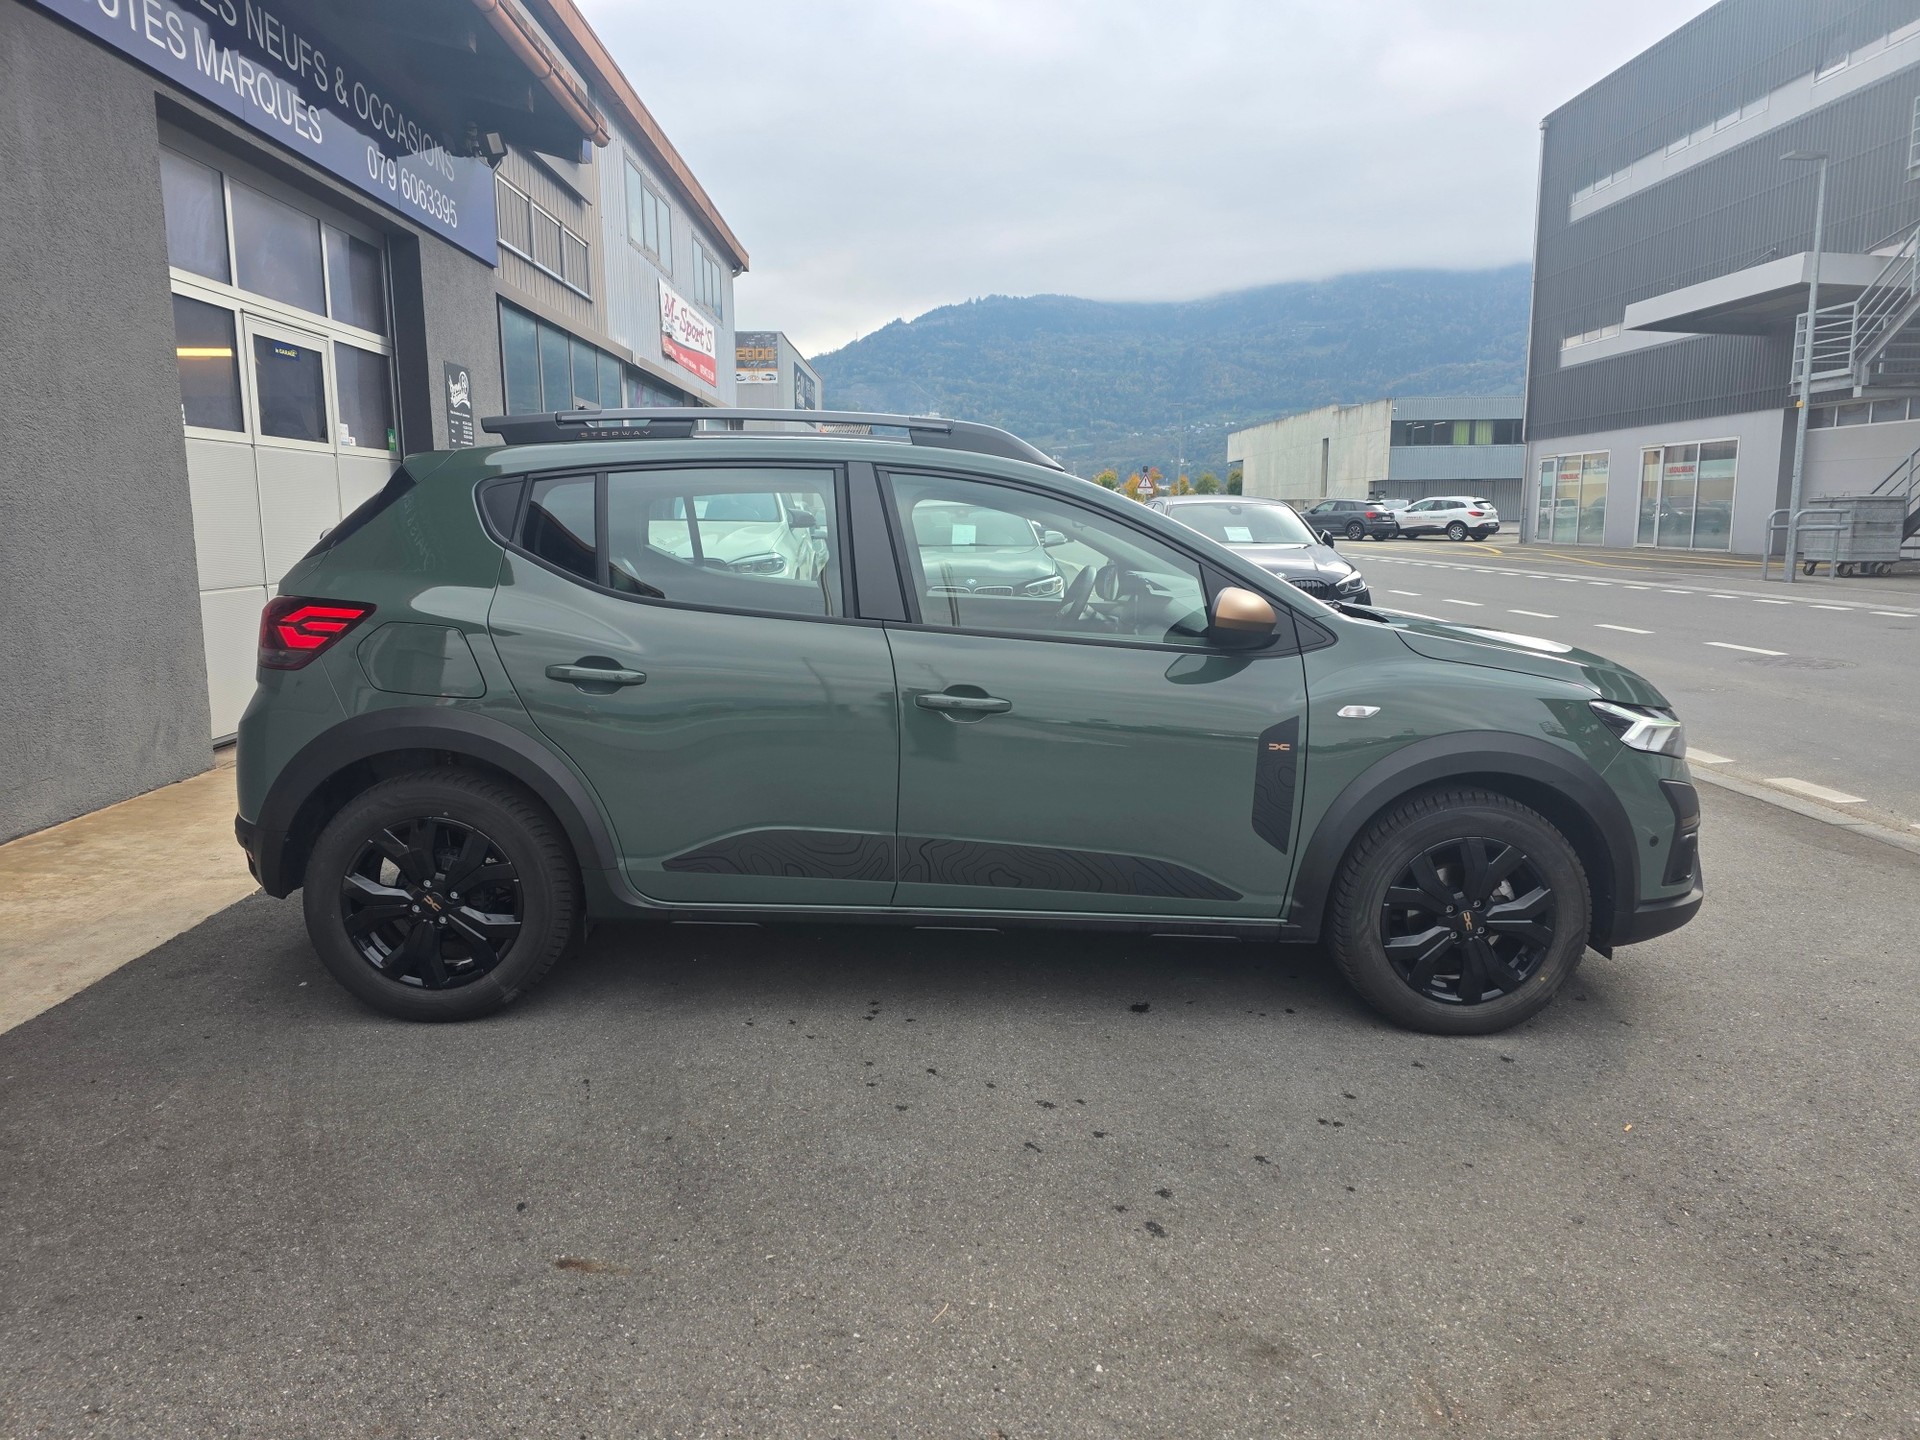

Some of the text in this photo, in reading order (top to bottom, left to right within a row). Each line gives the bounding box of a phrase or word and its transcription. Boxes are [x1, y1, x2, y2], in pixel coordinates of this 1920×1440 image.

[193, 27, 323, 144] MARQUES
[245, 0, 455, 182] NEUFS & OCCASIONS
[366, 146, 458, 228] 079 6063395
[581, 430, 651, 438] STEPWAY
